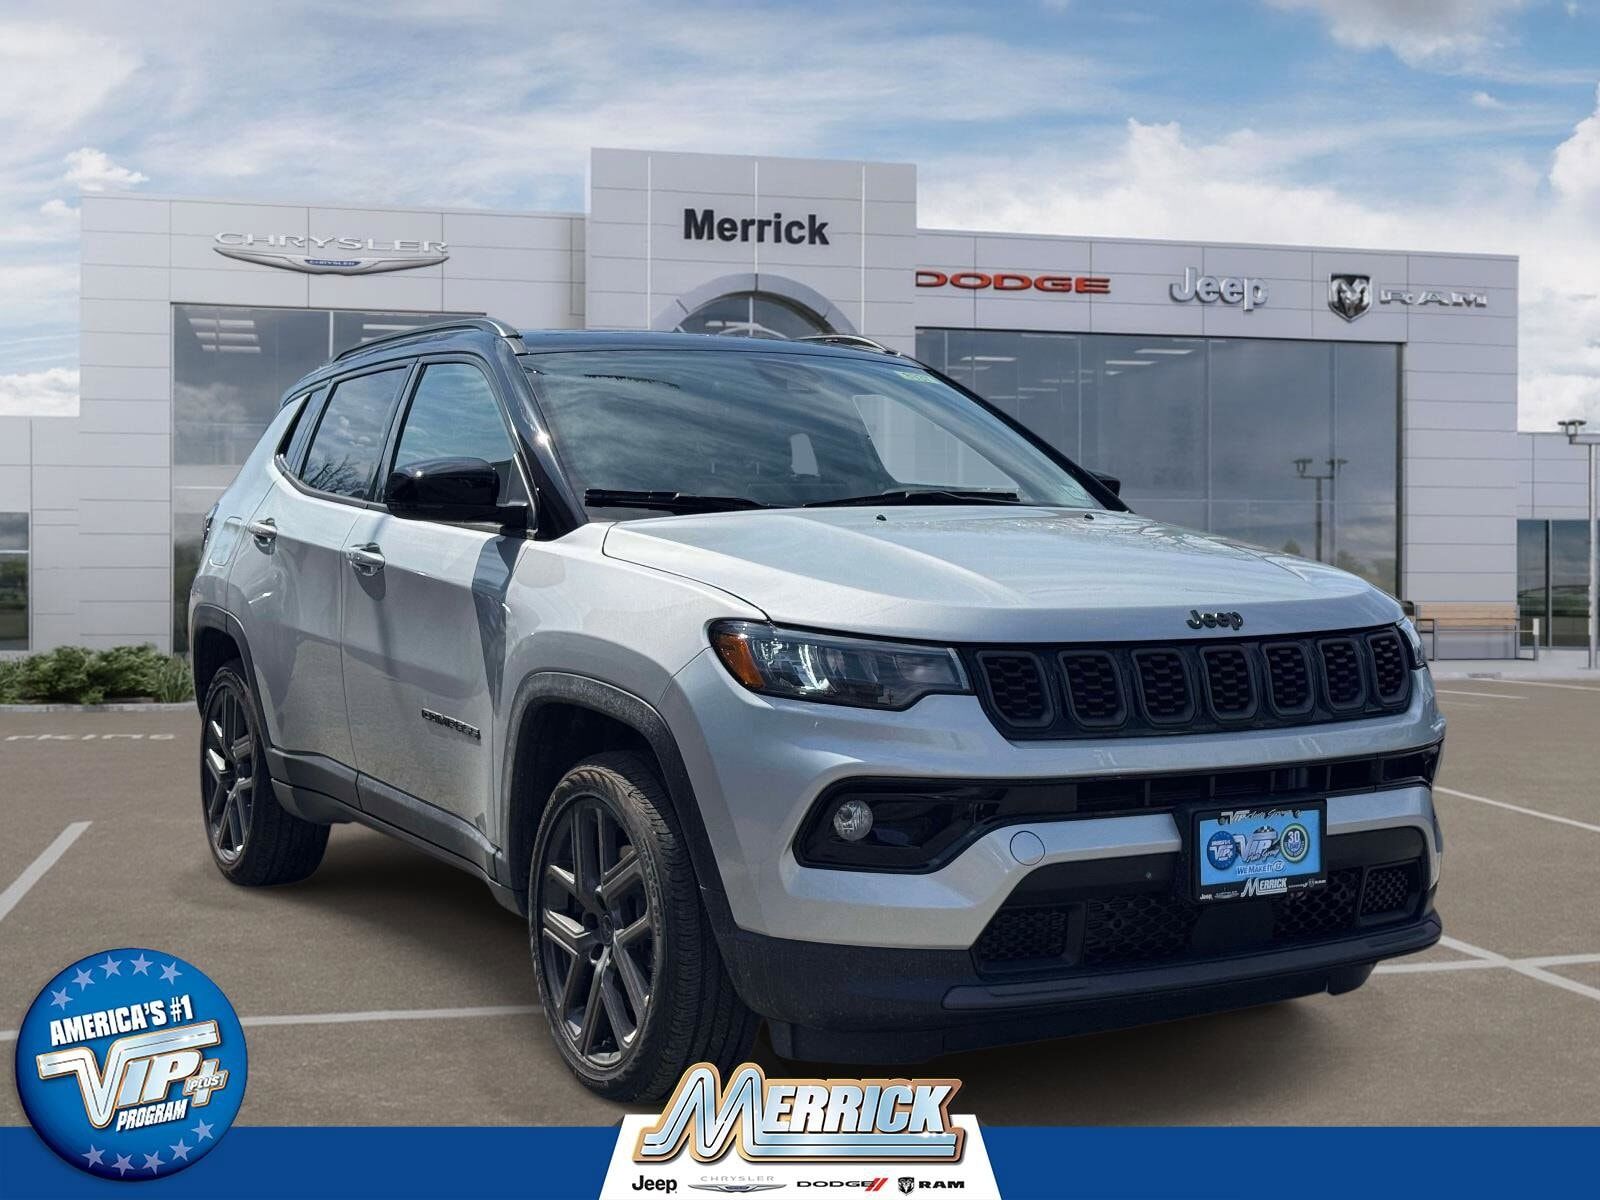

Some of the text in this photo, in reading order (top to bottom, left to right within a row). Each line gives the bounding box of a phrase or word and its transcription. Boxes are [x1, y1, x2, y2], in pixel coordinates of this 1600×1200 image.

[684, 208, 830, 245] Merrick
[214, 231, 449, 253] CHRYSLER
[915, 271, 1111, 294] DODGE
[1169, 267, 1269, 311] Jeep
[1379, 289, 1488, 308] RAM
[1186, 609, 1244, 631] Jeep
[1233, 831, 1277, 861] VIP
[1287, 830, 1301, 843] 30
[1240, 877, 1288, 898] MERRICK
